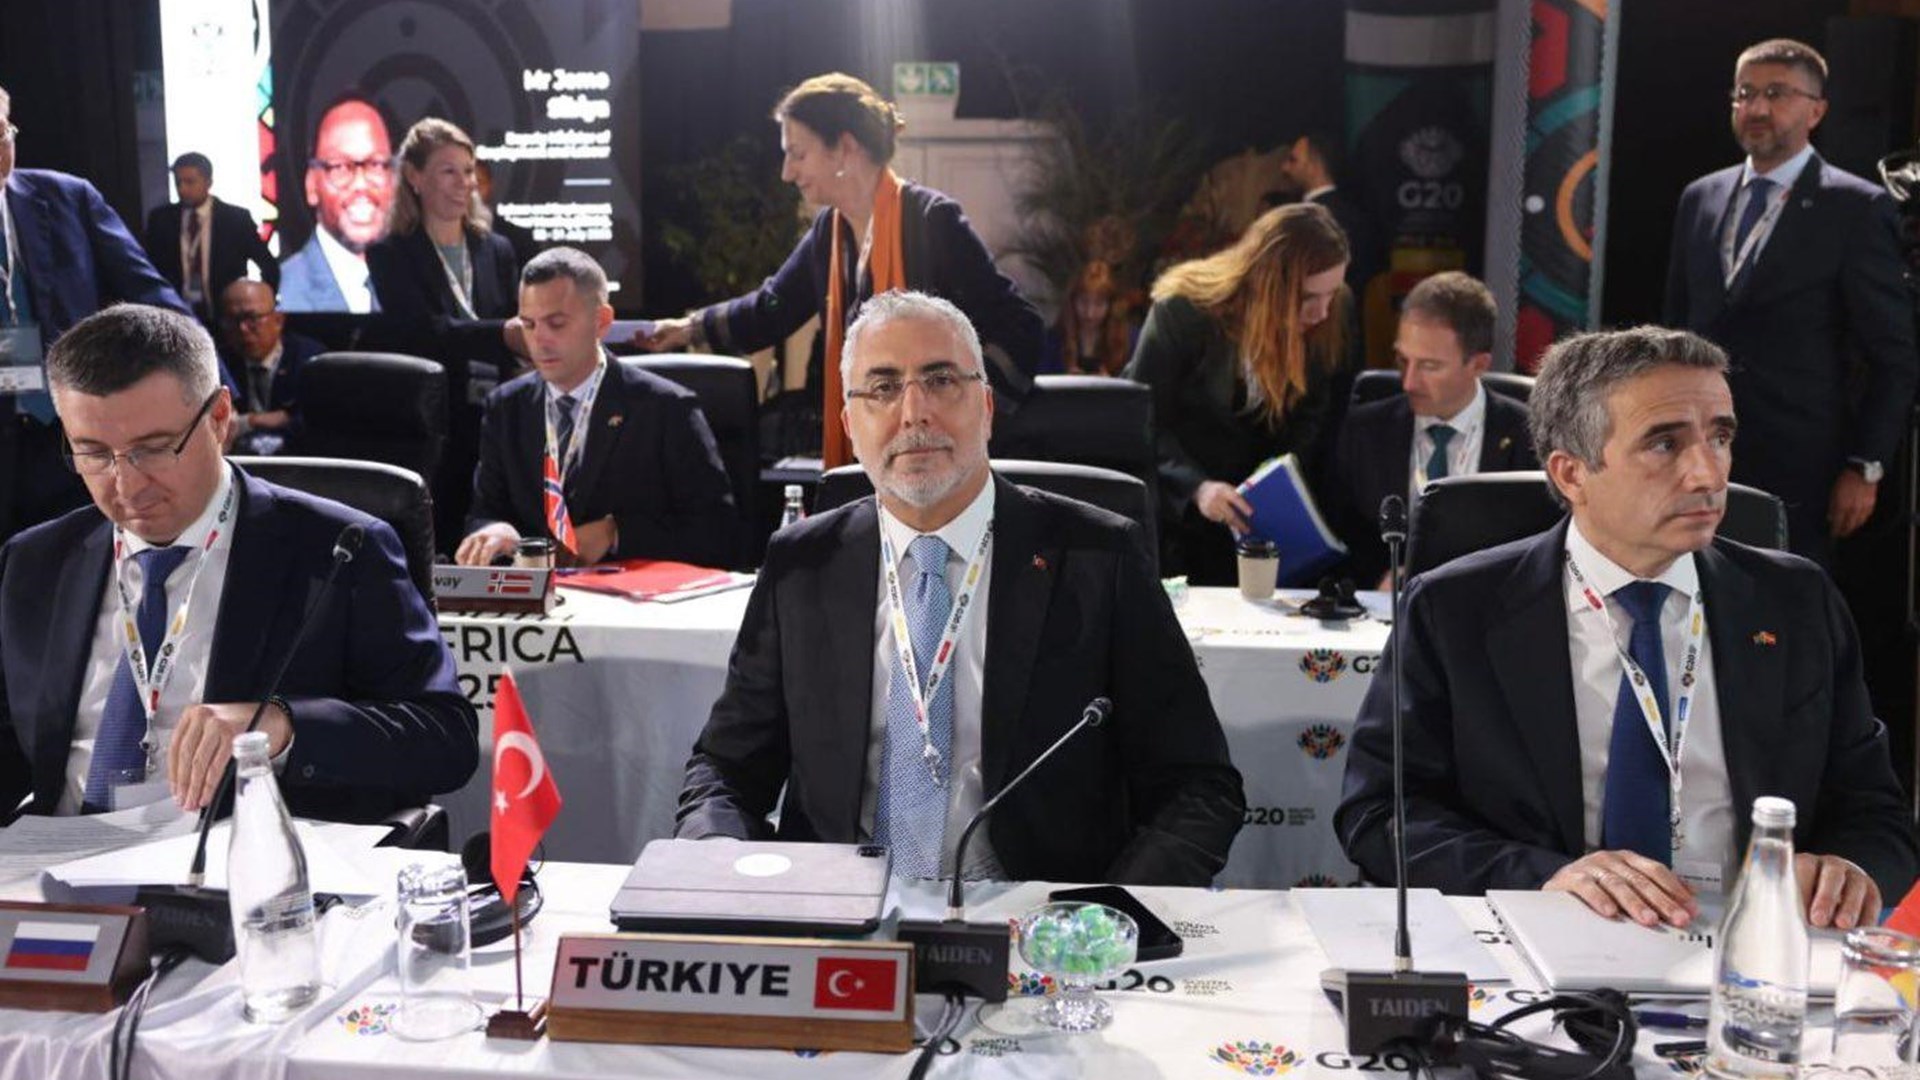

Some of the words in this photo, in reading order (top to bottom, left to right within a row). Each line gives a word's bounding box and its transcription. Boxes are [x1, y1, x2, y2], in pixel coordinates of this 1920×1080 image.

[1399, 181, 1463, 208] G20
[438, 625, 584, 663] FRICA
[569, 951, 790, 997] TÜRKIYE
[1368, 997, 1448, 1017] TAIDEN
